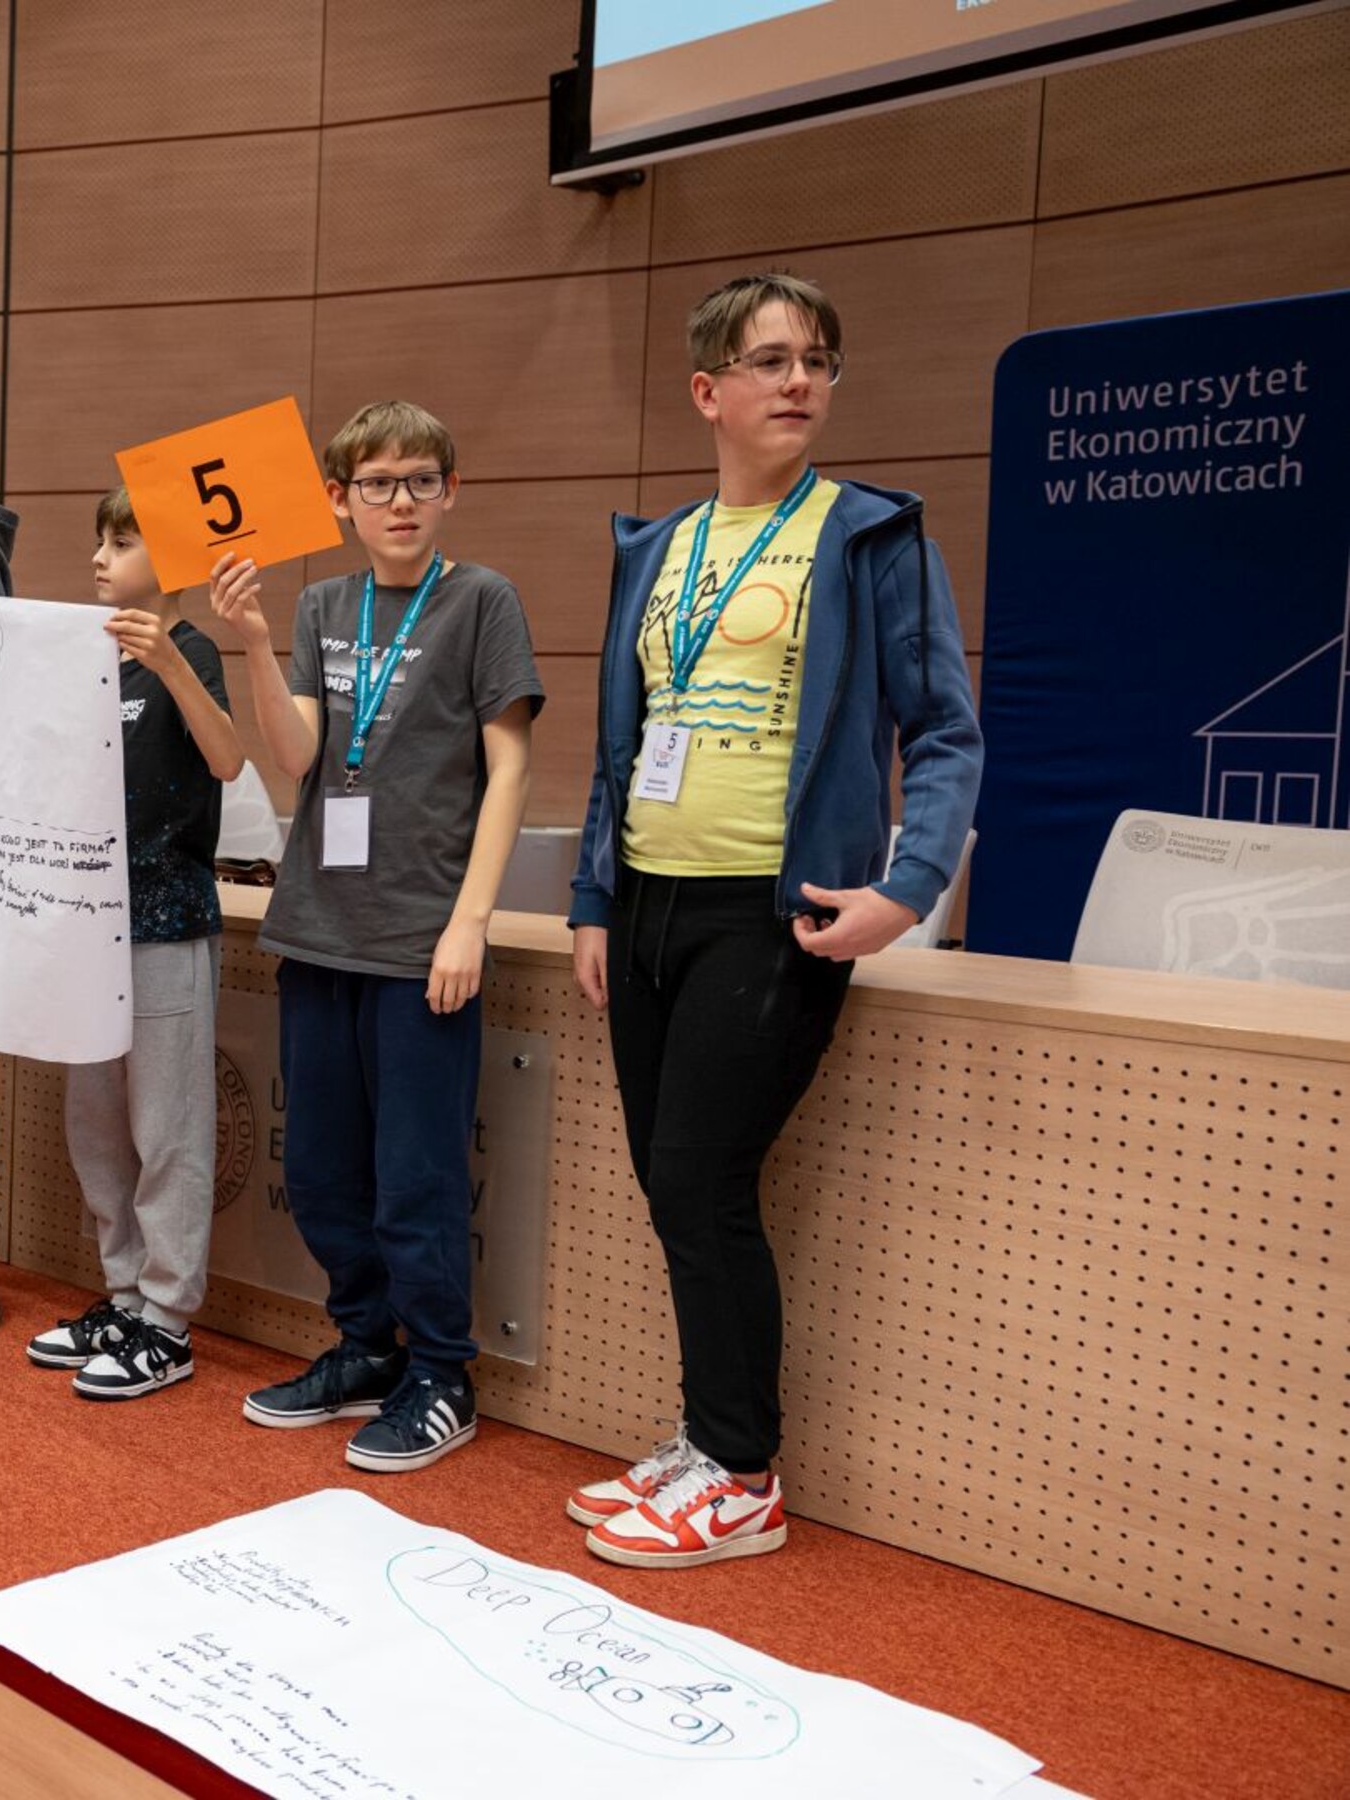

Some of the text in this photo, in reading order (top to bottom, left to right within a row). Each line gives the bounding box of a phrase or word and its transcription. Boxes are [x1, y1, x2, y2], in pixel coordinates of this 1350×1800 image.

[1049, 360, 1308, 418] Uniwersytet
[1048, 414, 1305, 461] Ekonomiczny
[191, 458, 242, 535] 5
[1044, 454, 1303, 505] w Katowicach
[767, 645, 799, 737] SUNSHINE
[667, 732, 679, 750] 5
[413, 1558, 531, 1612] Deep
[543, 1604, 651, 1664] Ocean
